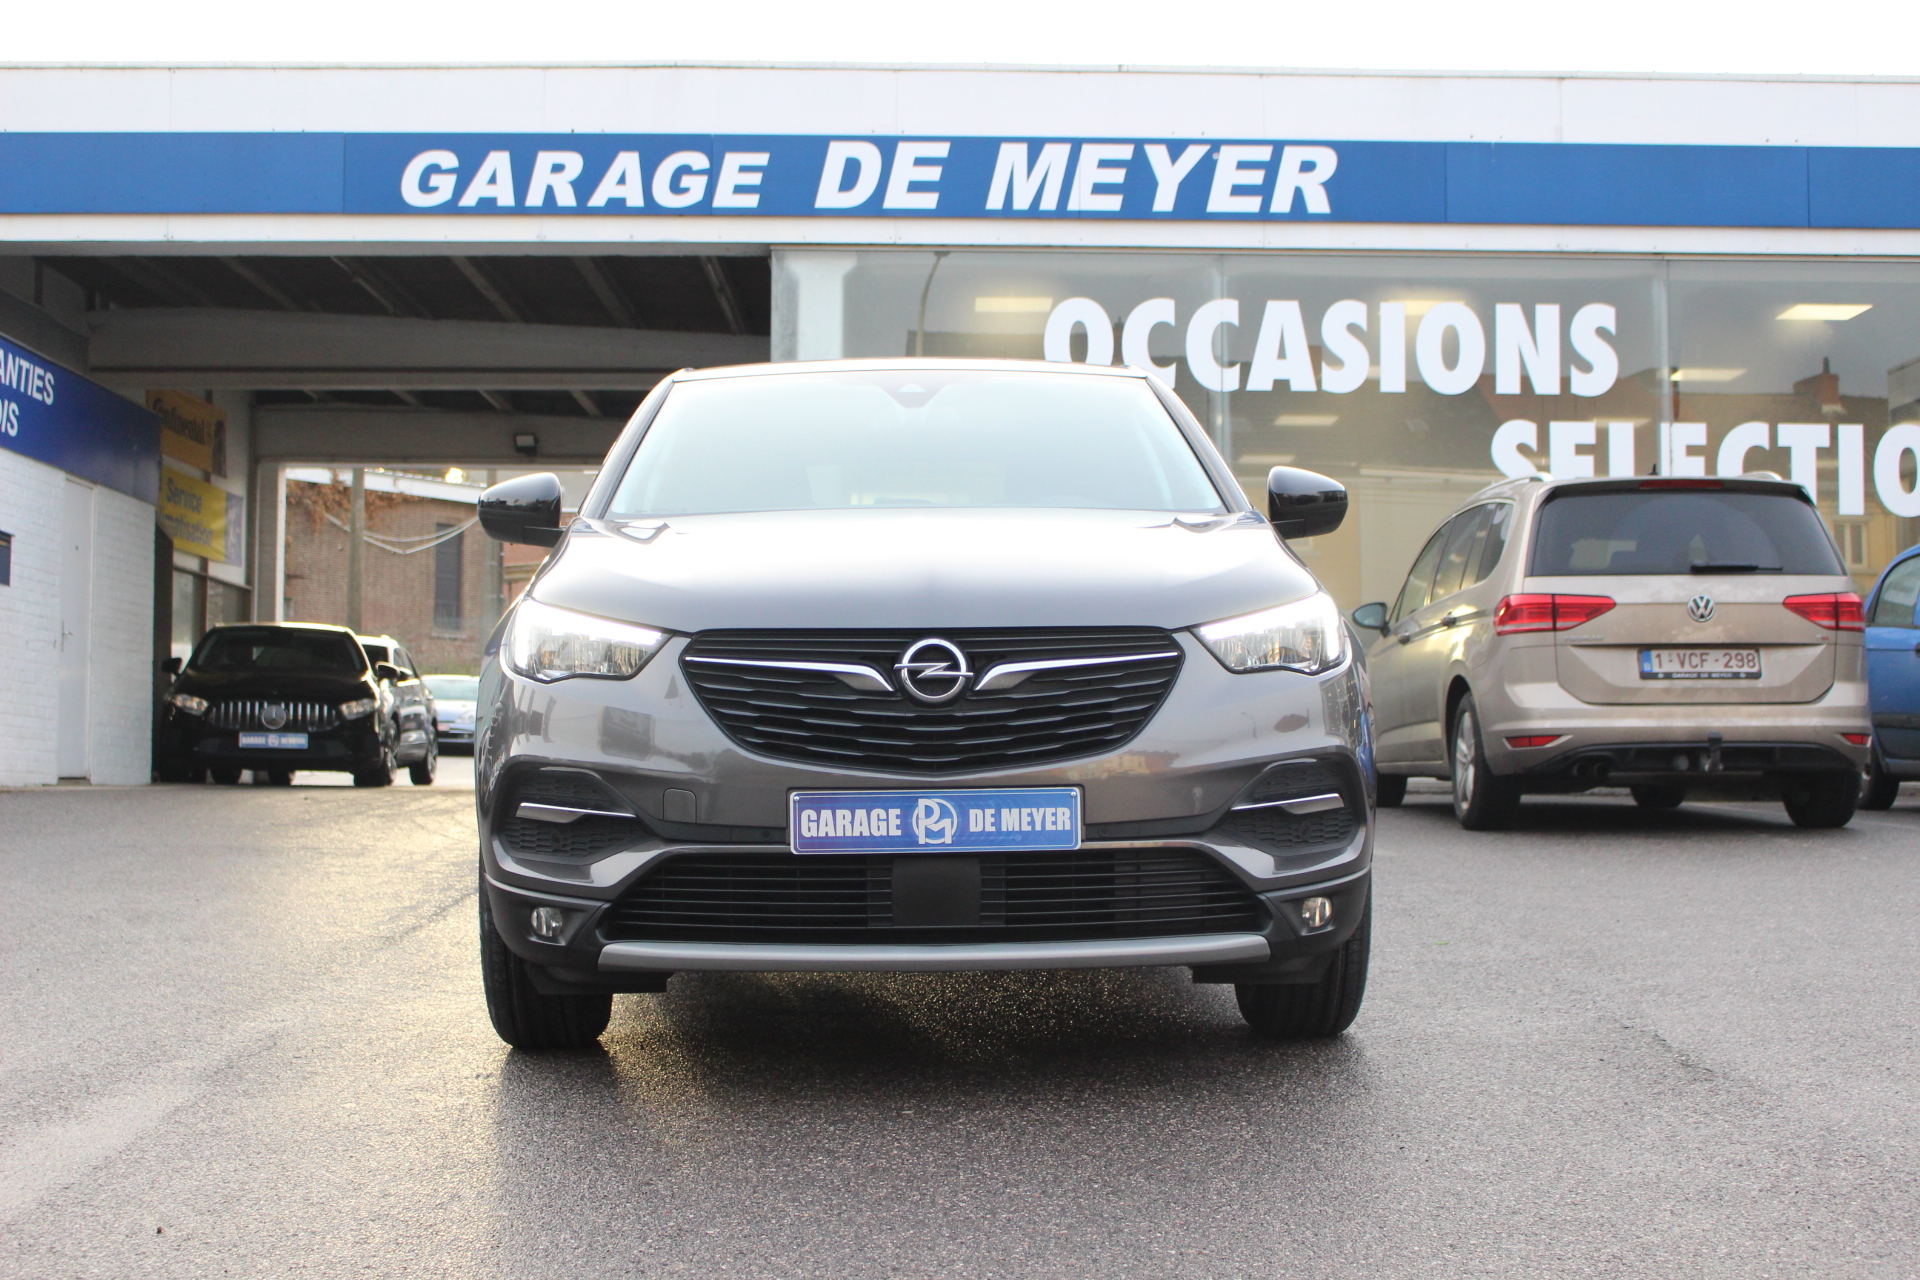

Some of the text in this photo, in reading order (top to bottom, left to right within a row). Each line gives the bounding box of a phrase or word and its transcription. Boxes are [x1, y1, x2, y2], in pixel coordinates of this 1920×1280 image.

[400, 141, 1338, 214] GARAGE DE MEYER
[1044, 297, 1619, 397] OCCASIONS
[0, 398, 19, 437] IS
[167, 476, 202, 514] Service
[801, 808, 902, 838] GARAGE
[969, 808, 995, 832] DE
[1001, 807, 1071, 831] MEYER
